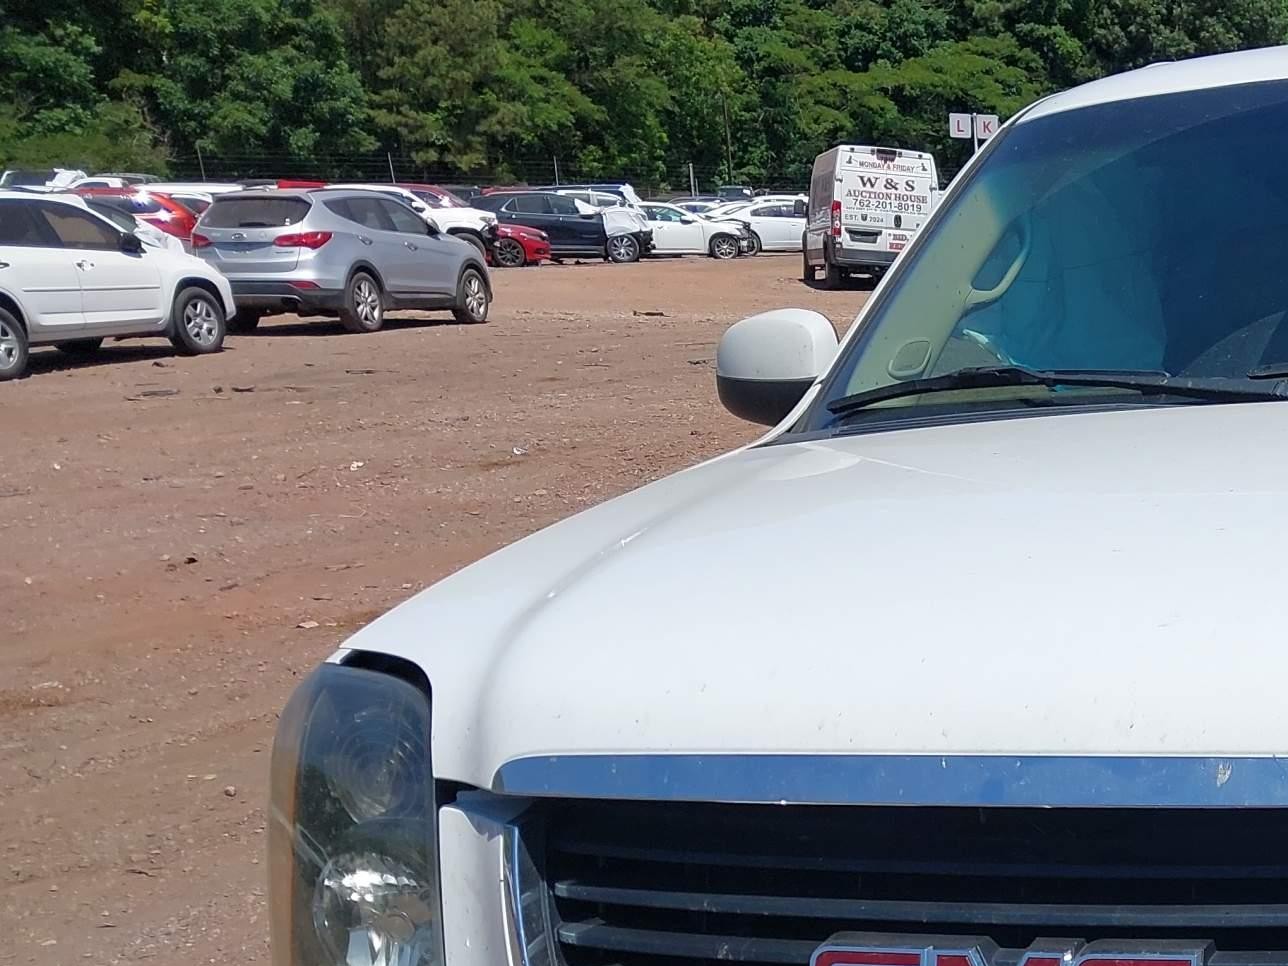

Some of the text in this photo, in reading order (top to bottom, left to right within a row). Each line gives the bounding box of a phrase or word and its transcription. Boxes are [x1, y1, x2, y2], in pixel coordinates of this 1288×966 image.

[957, 120, 965, 132] L
[983, 120, 992, 133] K
[859, 160, 885, 170] MONDAY
[858, 176, 915, 192] W & S
[846, 189, 928, 204] AUCTION HOUSE
[853, 198, 922, 212] 762-201-8019
[844, 213, 859, 221] EST.
